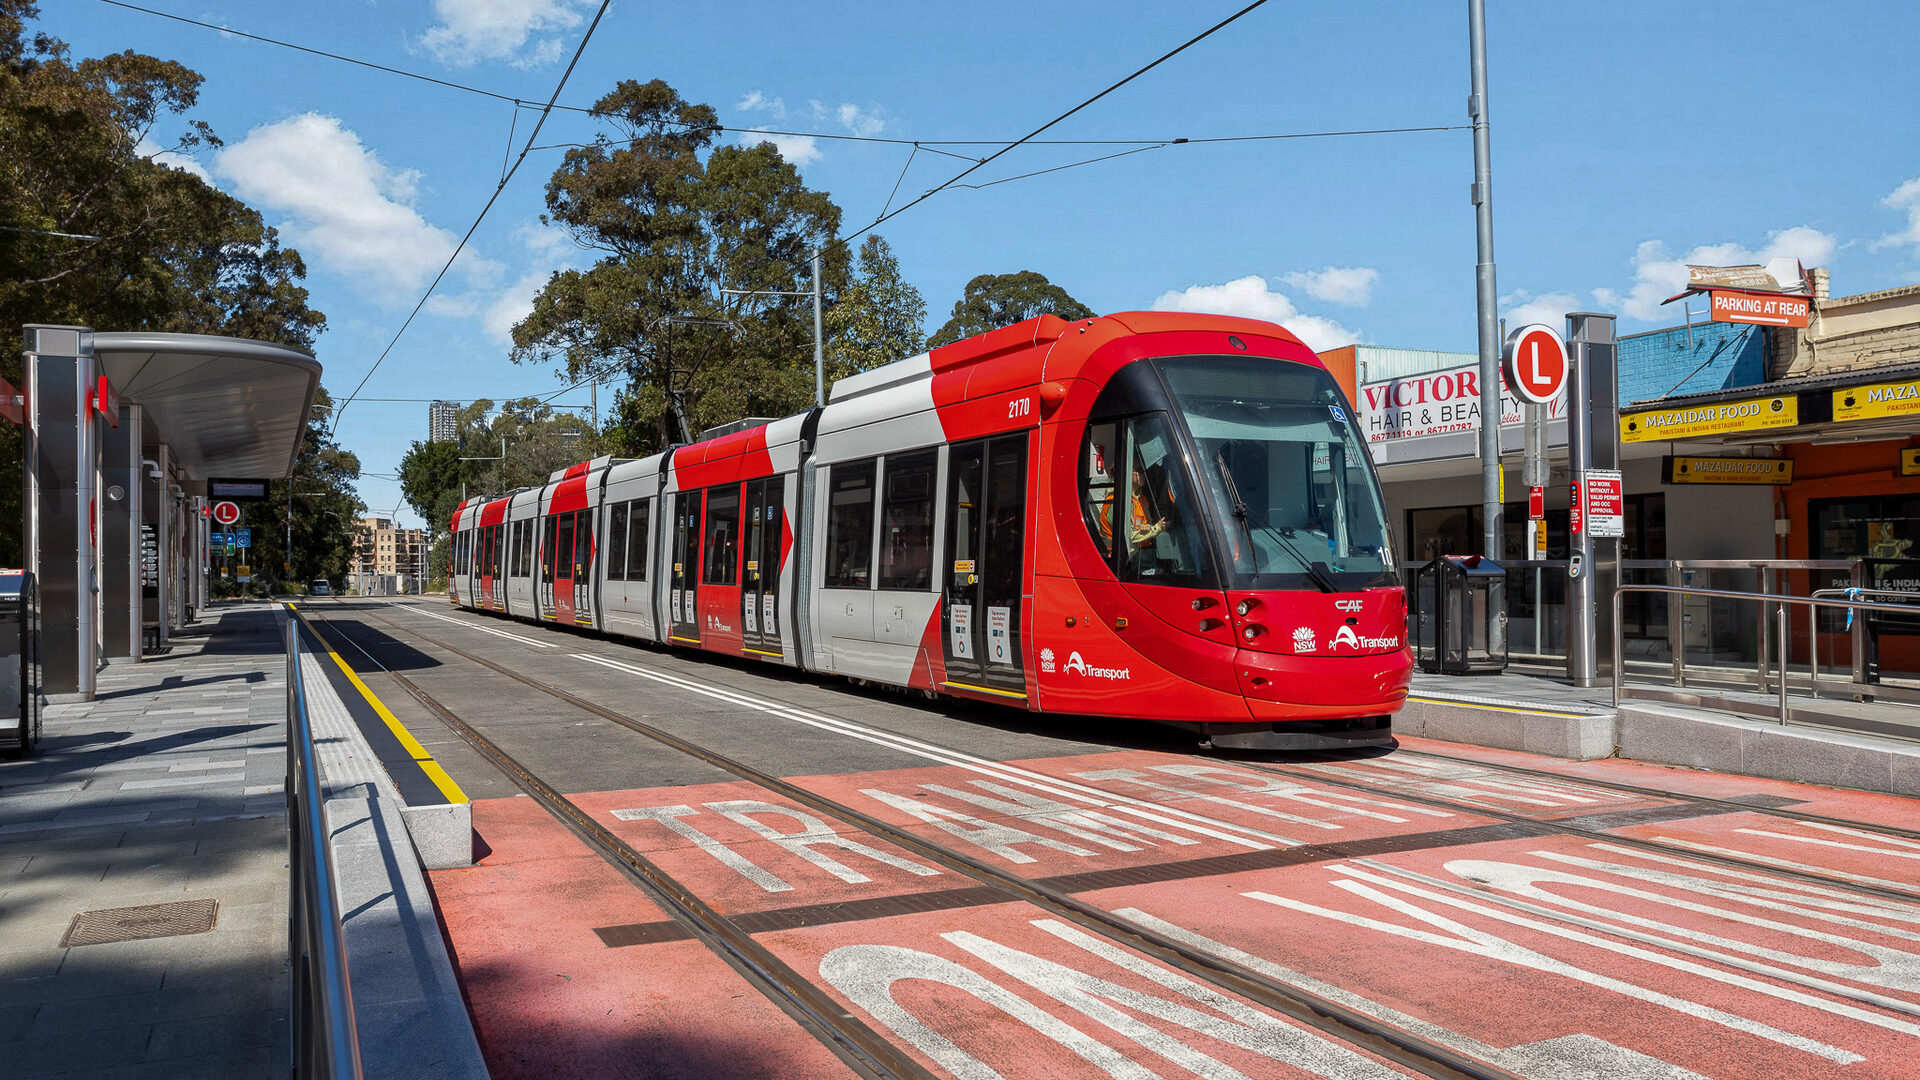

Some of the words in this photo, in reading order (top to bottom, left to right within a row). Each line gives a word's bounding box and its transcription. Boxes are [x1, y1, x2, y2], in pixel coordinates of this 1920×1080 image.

[1715, 297, 1761, 313] PARKING
[1764, 301, 1777, 314] AT
[1779, 302, 1806, 316] REAR
[1531, 341, 1552, 384] L
[1363, 367, 1509, 411] VICTOR
[1868, 385, 1919, 403] MAZA
[1008, 397, 1030, 418] 2170
[1370, 411, 1412, 431] HAIR
[1420, 409, 1432, 425] &
[1441, 396, 1520, 422] BEATY
[1646, 408, 1716, 428] MAZAIDAR
[1719, 403, 1760, 420] FOOD
[1659, 427, 1685, 435] PAKISTANI
[1710, 420, 1745, 429] RESTAURANT
[1694, 461, 1744, 472] MAZAIDAR
[1745, 462, 1772, 473] FOOD
[222, 506, 231, 519] L
[1378, 546, 1393, 566] 10
[1334, 600, 1363, 613] CAF
[1294, 640, 1316, 650] NSW
[1358, 635, 1399, 650] Transport
[1041, 661, 1055, 670] NSW
[1085, 664, 1130, 681] Transport
[609, 780, 1201, 892] TRAM
